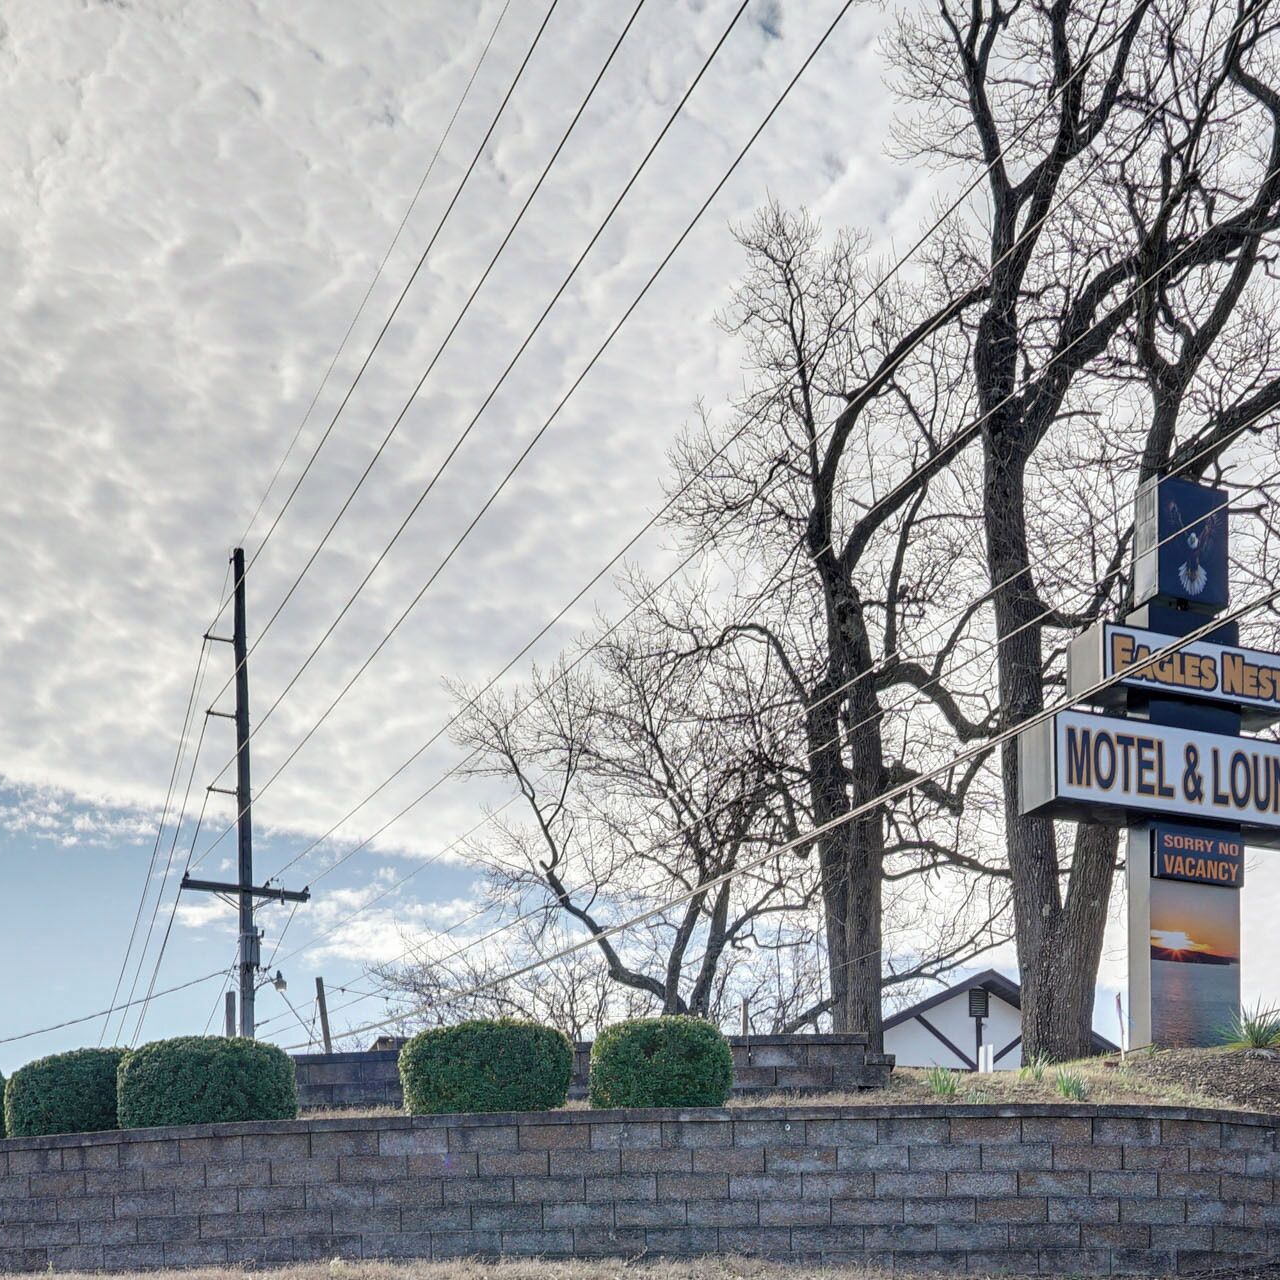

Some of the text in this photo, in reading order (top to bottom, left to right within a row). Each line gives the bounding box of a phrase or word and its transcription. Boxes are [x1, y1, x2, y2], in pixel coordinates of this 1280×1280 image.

[1111, 632, 1218, 691] EAGLES
[1066, 725, 1174, 799] MOTEL
[1183, 742, 1203, 804] &
[1163, 834, 1239, 857] SORRY NO
[1163, 853, 1239, 882] VACANCY
